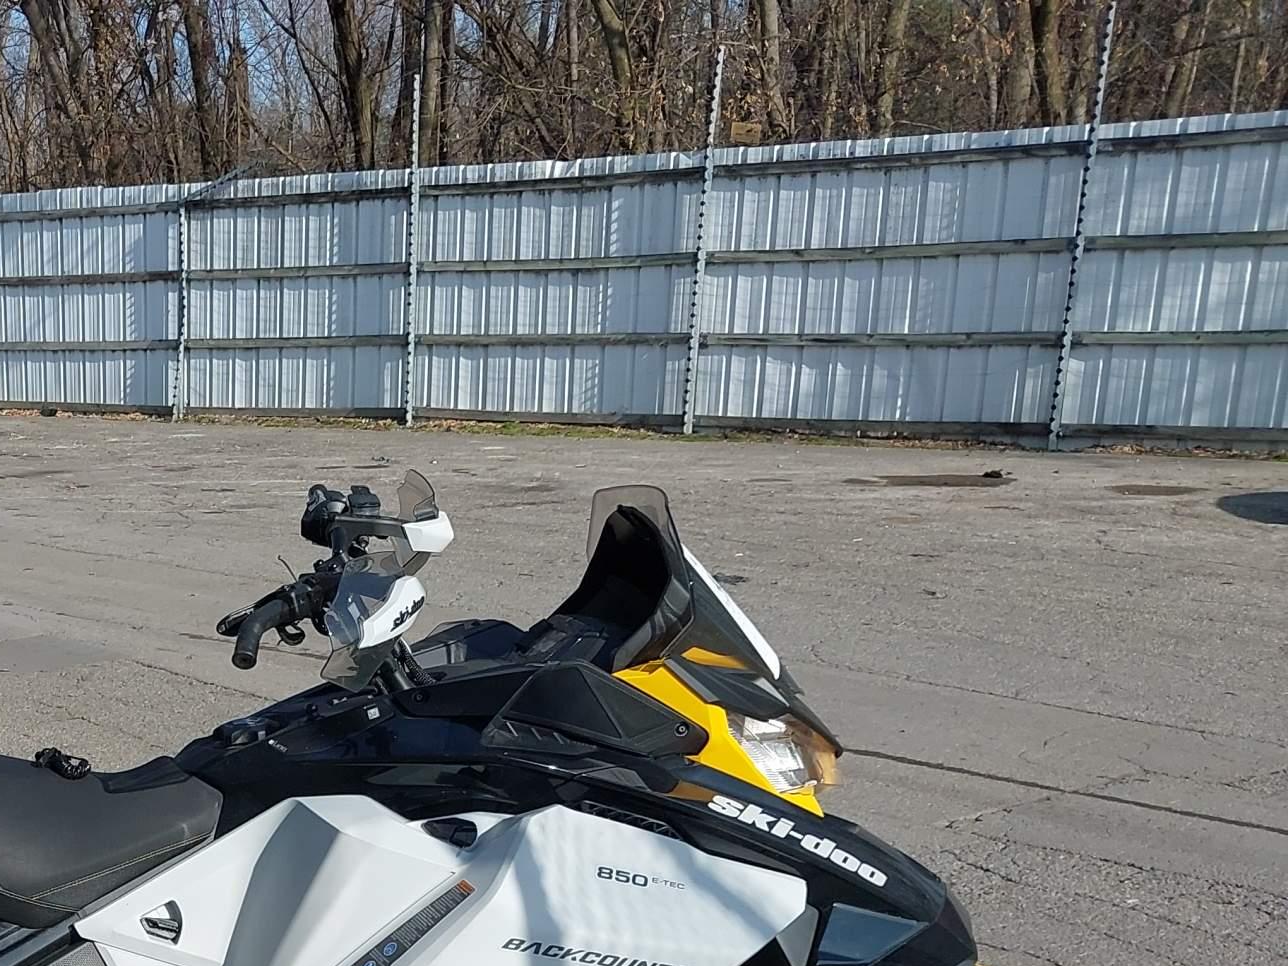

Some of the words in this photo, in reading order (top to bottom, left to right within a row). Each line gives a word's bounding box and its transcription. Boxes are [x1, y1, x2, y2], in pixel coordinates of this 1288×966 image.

[707, 794, 888, 888] ski-doo
[597, 866, 648, 888] 850
[651, 877, 686, 890] E-TEC
